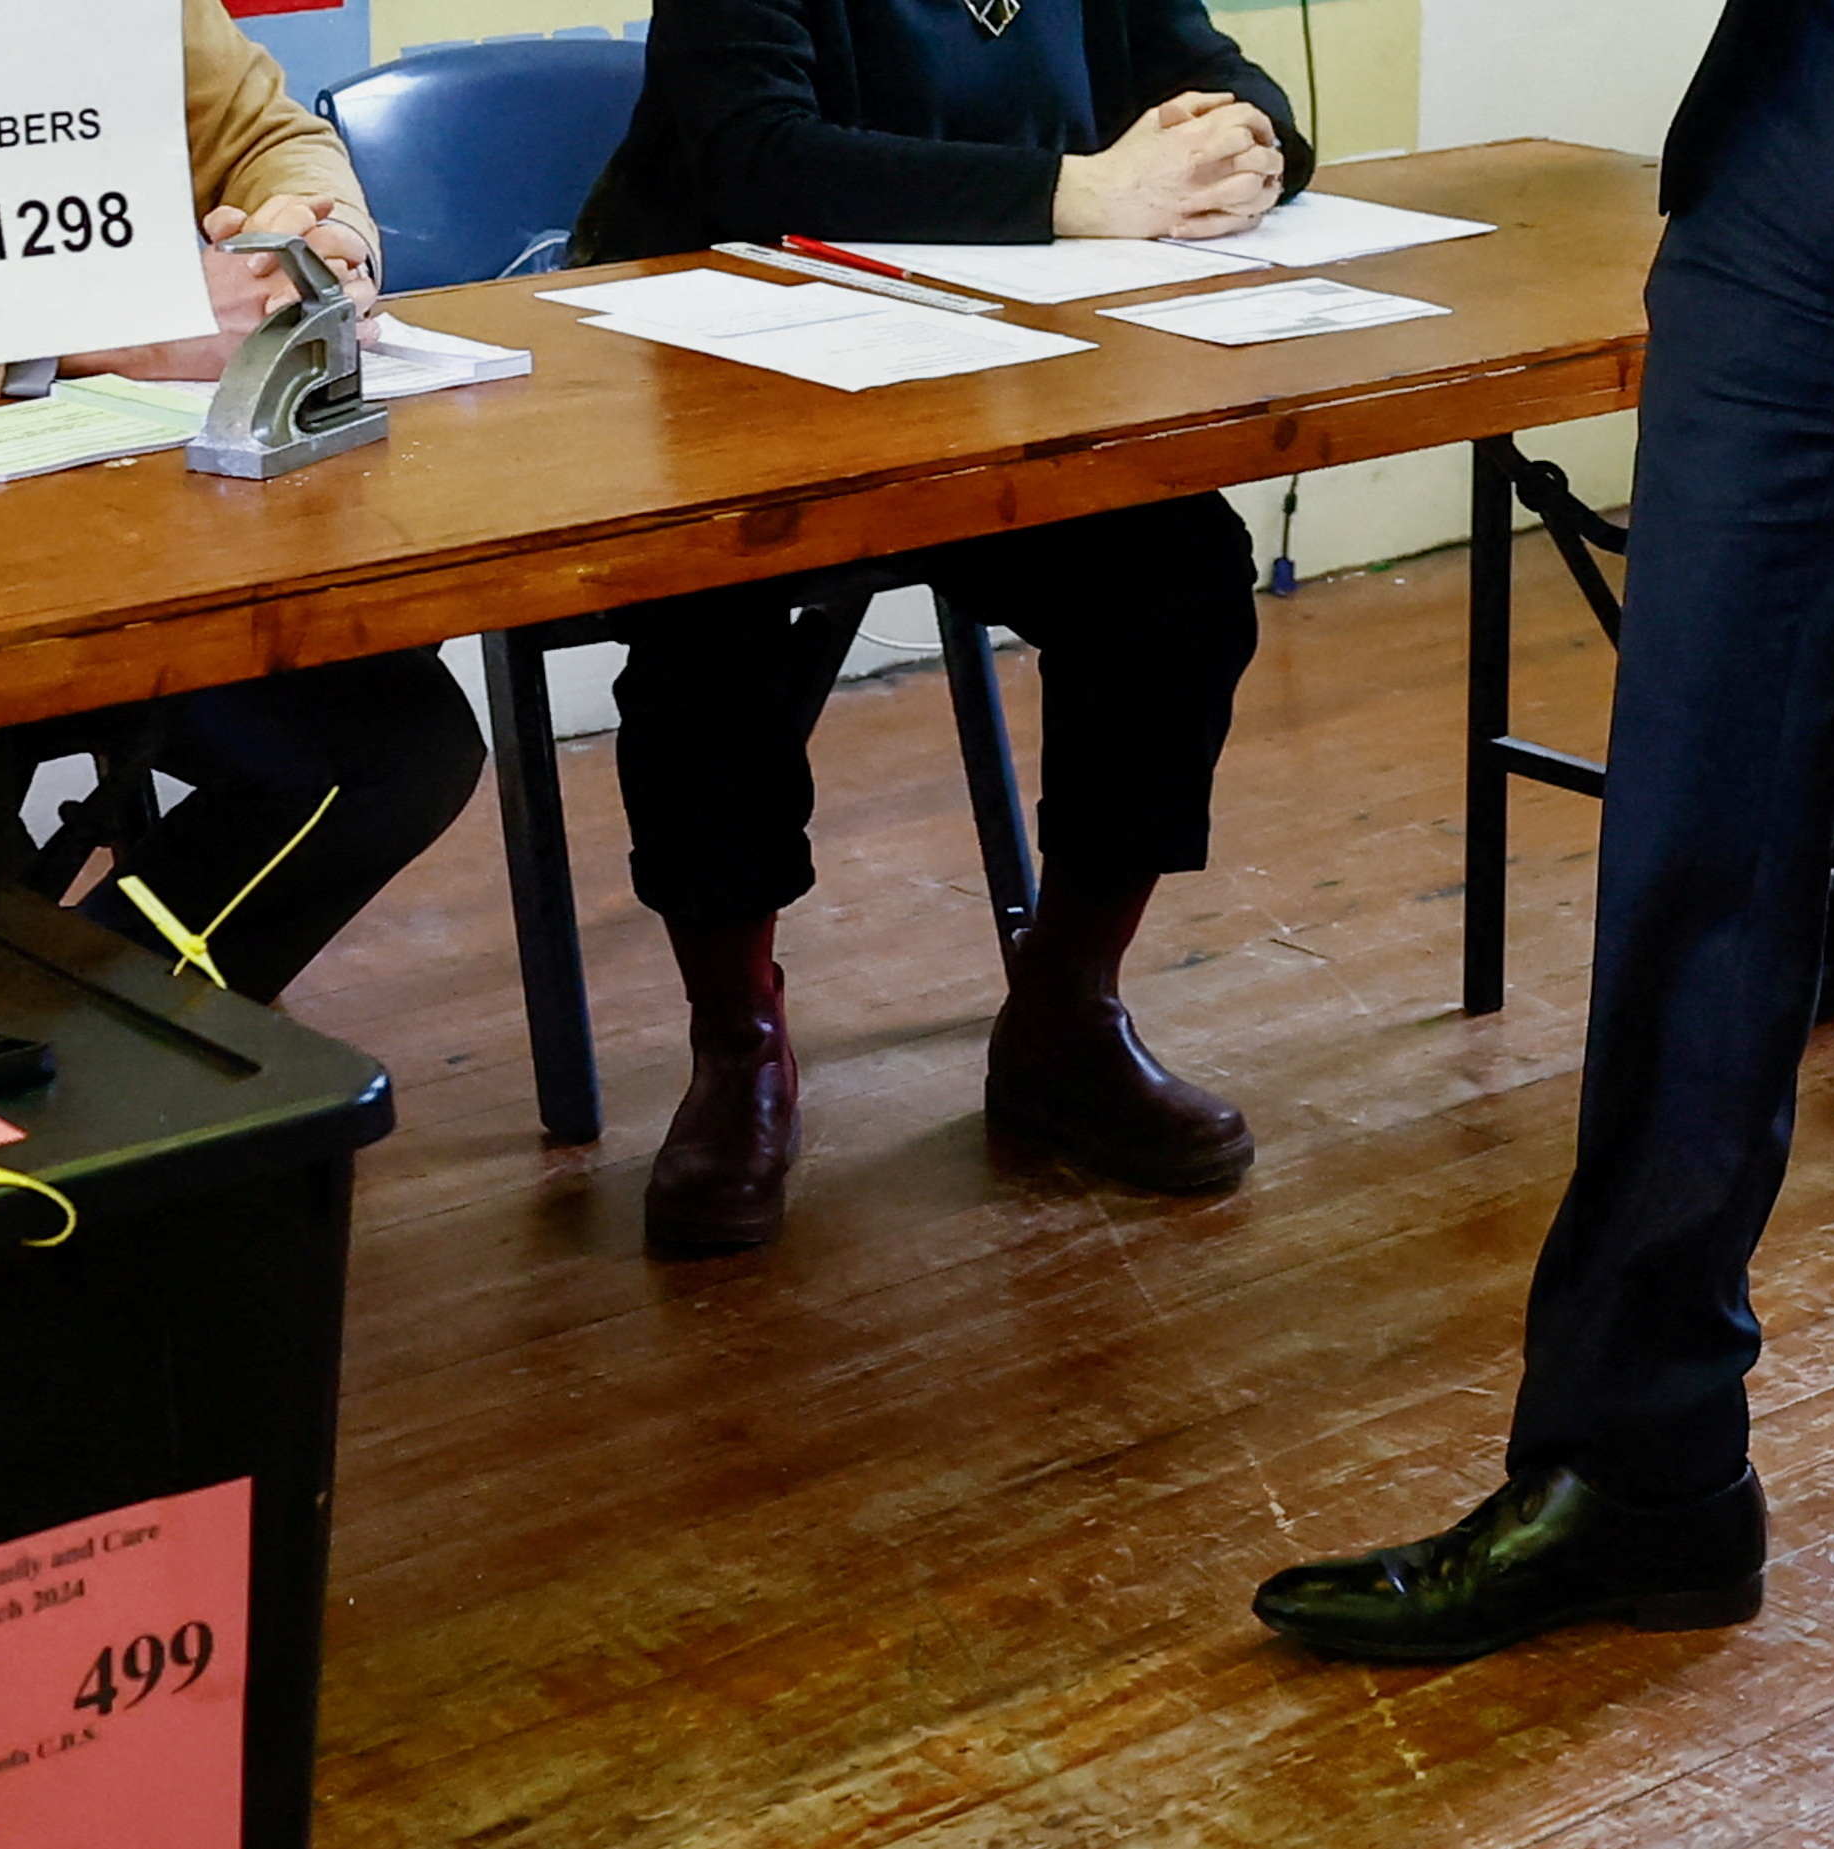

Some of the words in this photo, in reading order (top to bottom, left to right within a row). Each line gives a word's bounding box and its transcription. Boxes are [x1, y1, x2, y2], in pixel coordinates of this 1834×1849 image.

[51, 1537, 94, 1568] and
[103, 1524, 161, 1552] Care
[33, 1578, 86, 1613] 2024
[73, 1620, 214, 1717] 499
